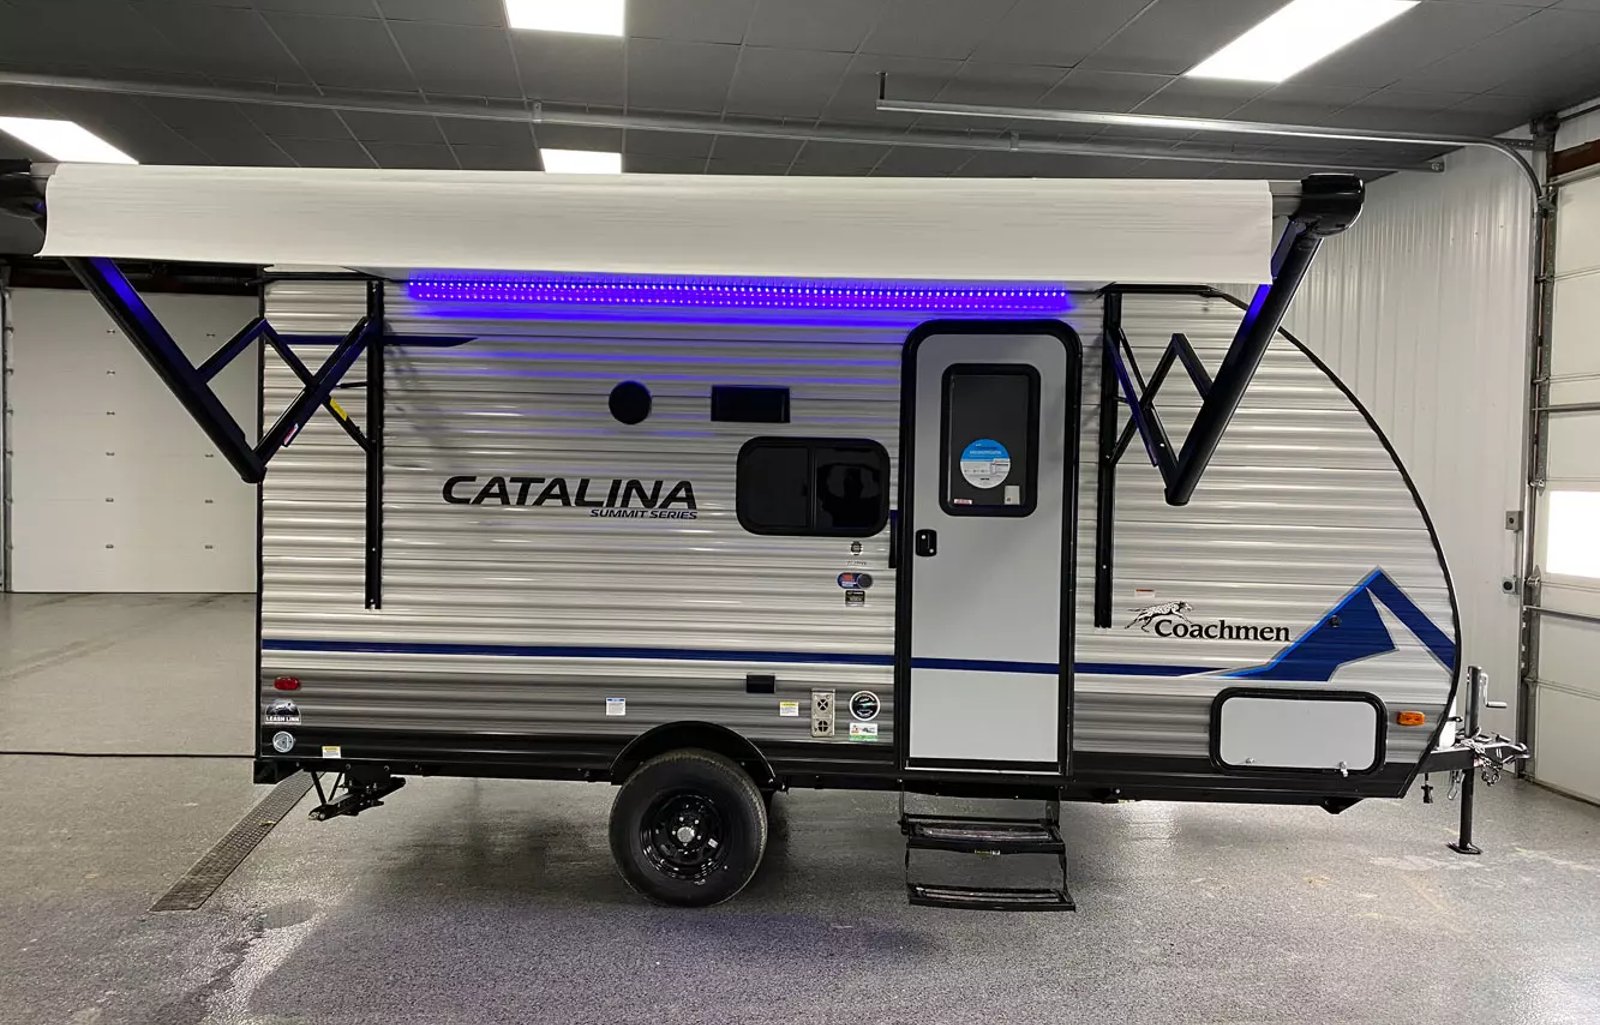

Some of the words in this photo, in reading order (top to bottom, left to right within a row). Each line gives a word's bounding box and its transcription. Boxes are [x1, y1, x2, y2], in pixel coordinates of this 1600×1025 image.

[442, 475, 698, 510] CATALINA
[590, 508, 648, 518] SUMMIT
[650, 509, 698, 520] SERIES
[1154, 619, 1290, 641] Coachmen
